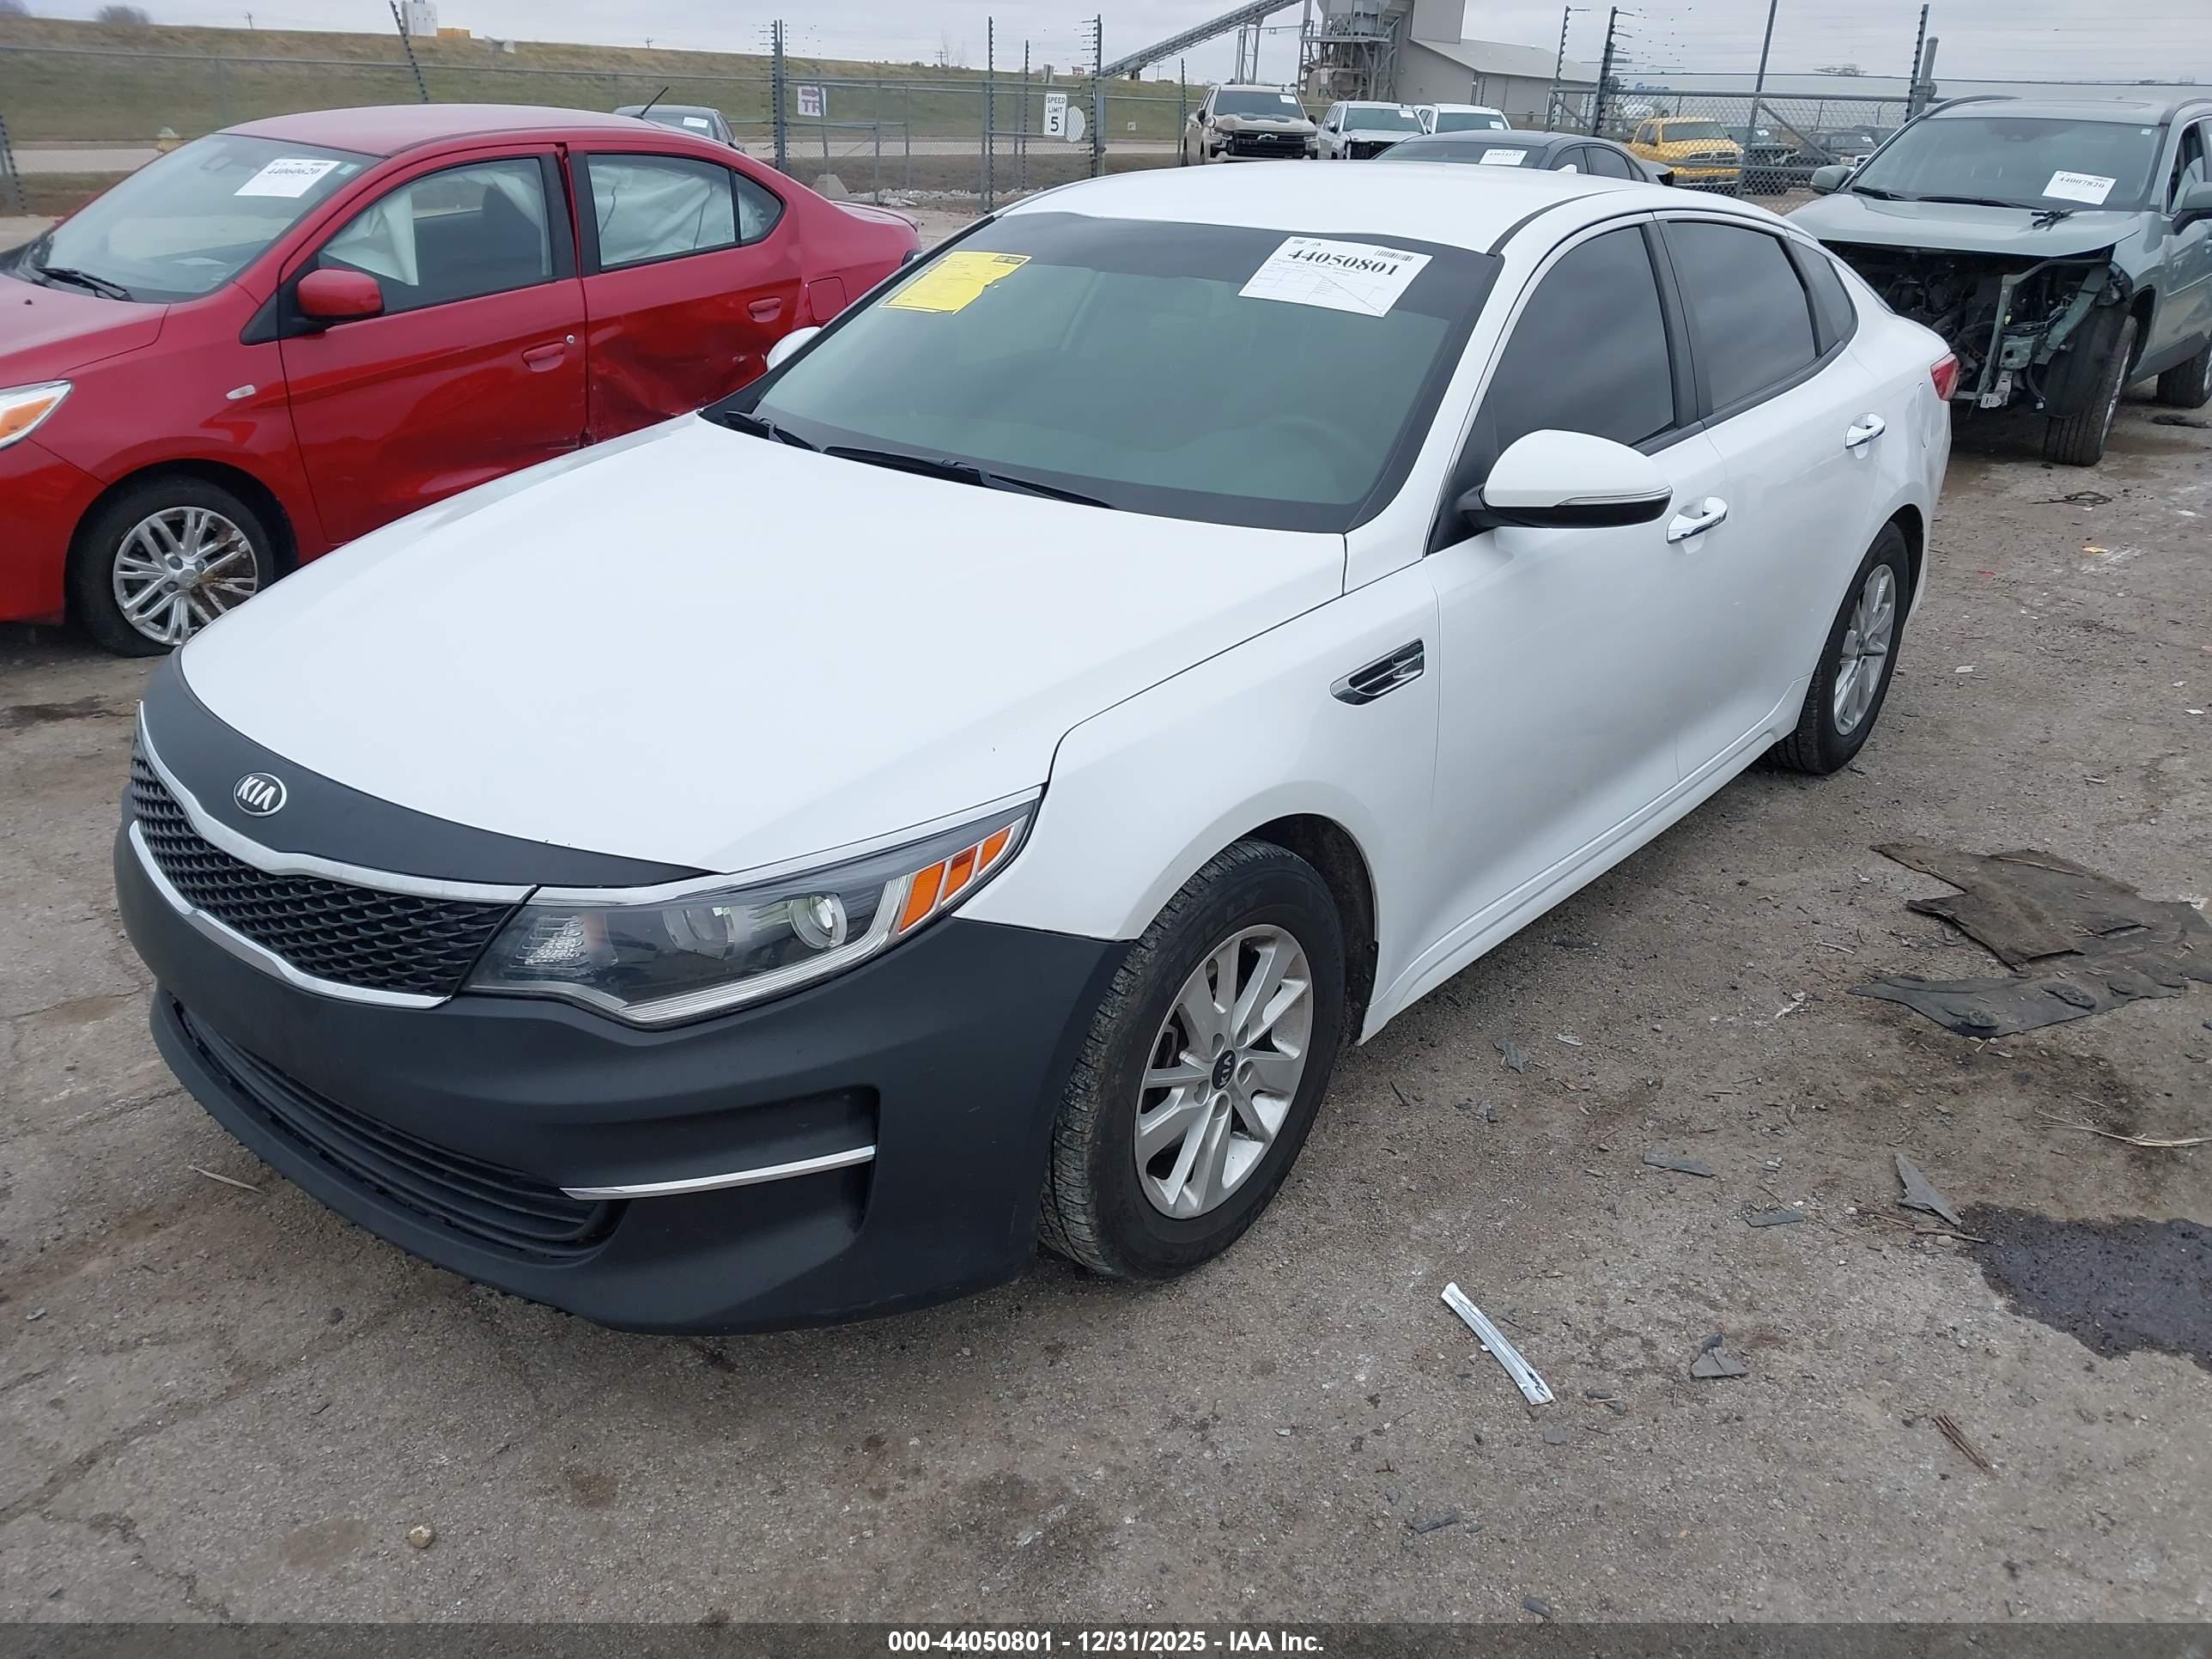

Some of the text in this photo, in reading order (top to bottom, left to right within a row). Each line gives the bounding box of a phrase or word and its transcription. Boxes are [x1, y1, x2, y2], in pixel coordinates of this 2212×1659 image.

[1049, 116, 1059, 132] 5
[1288, 249, 1399, 275] 44050801
[236, 775, 276, 811] KIA
[1219, 1054, 1231, 1086] KIA
